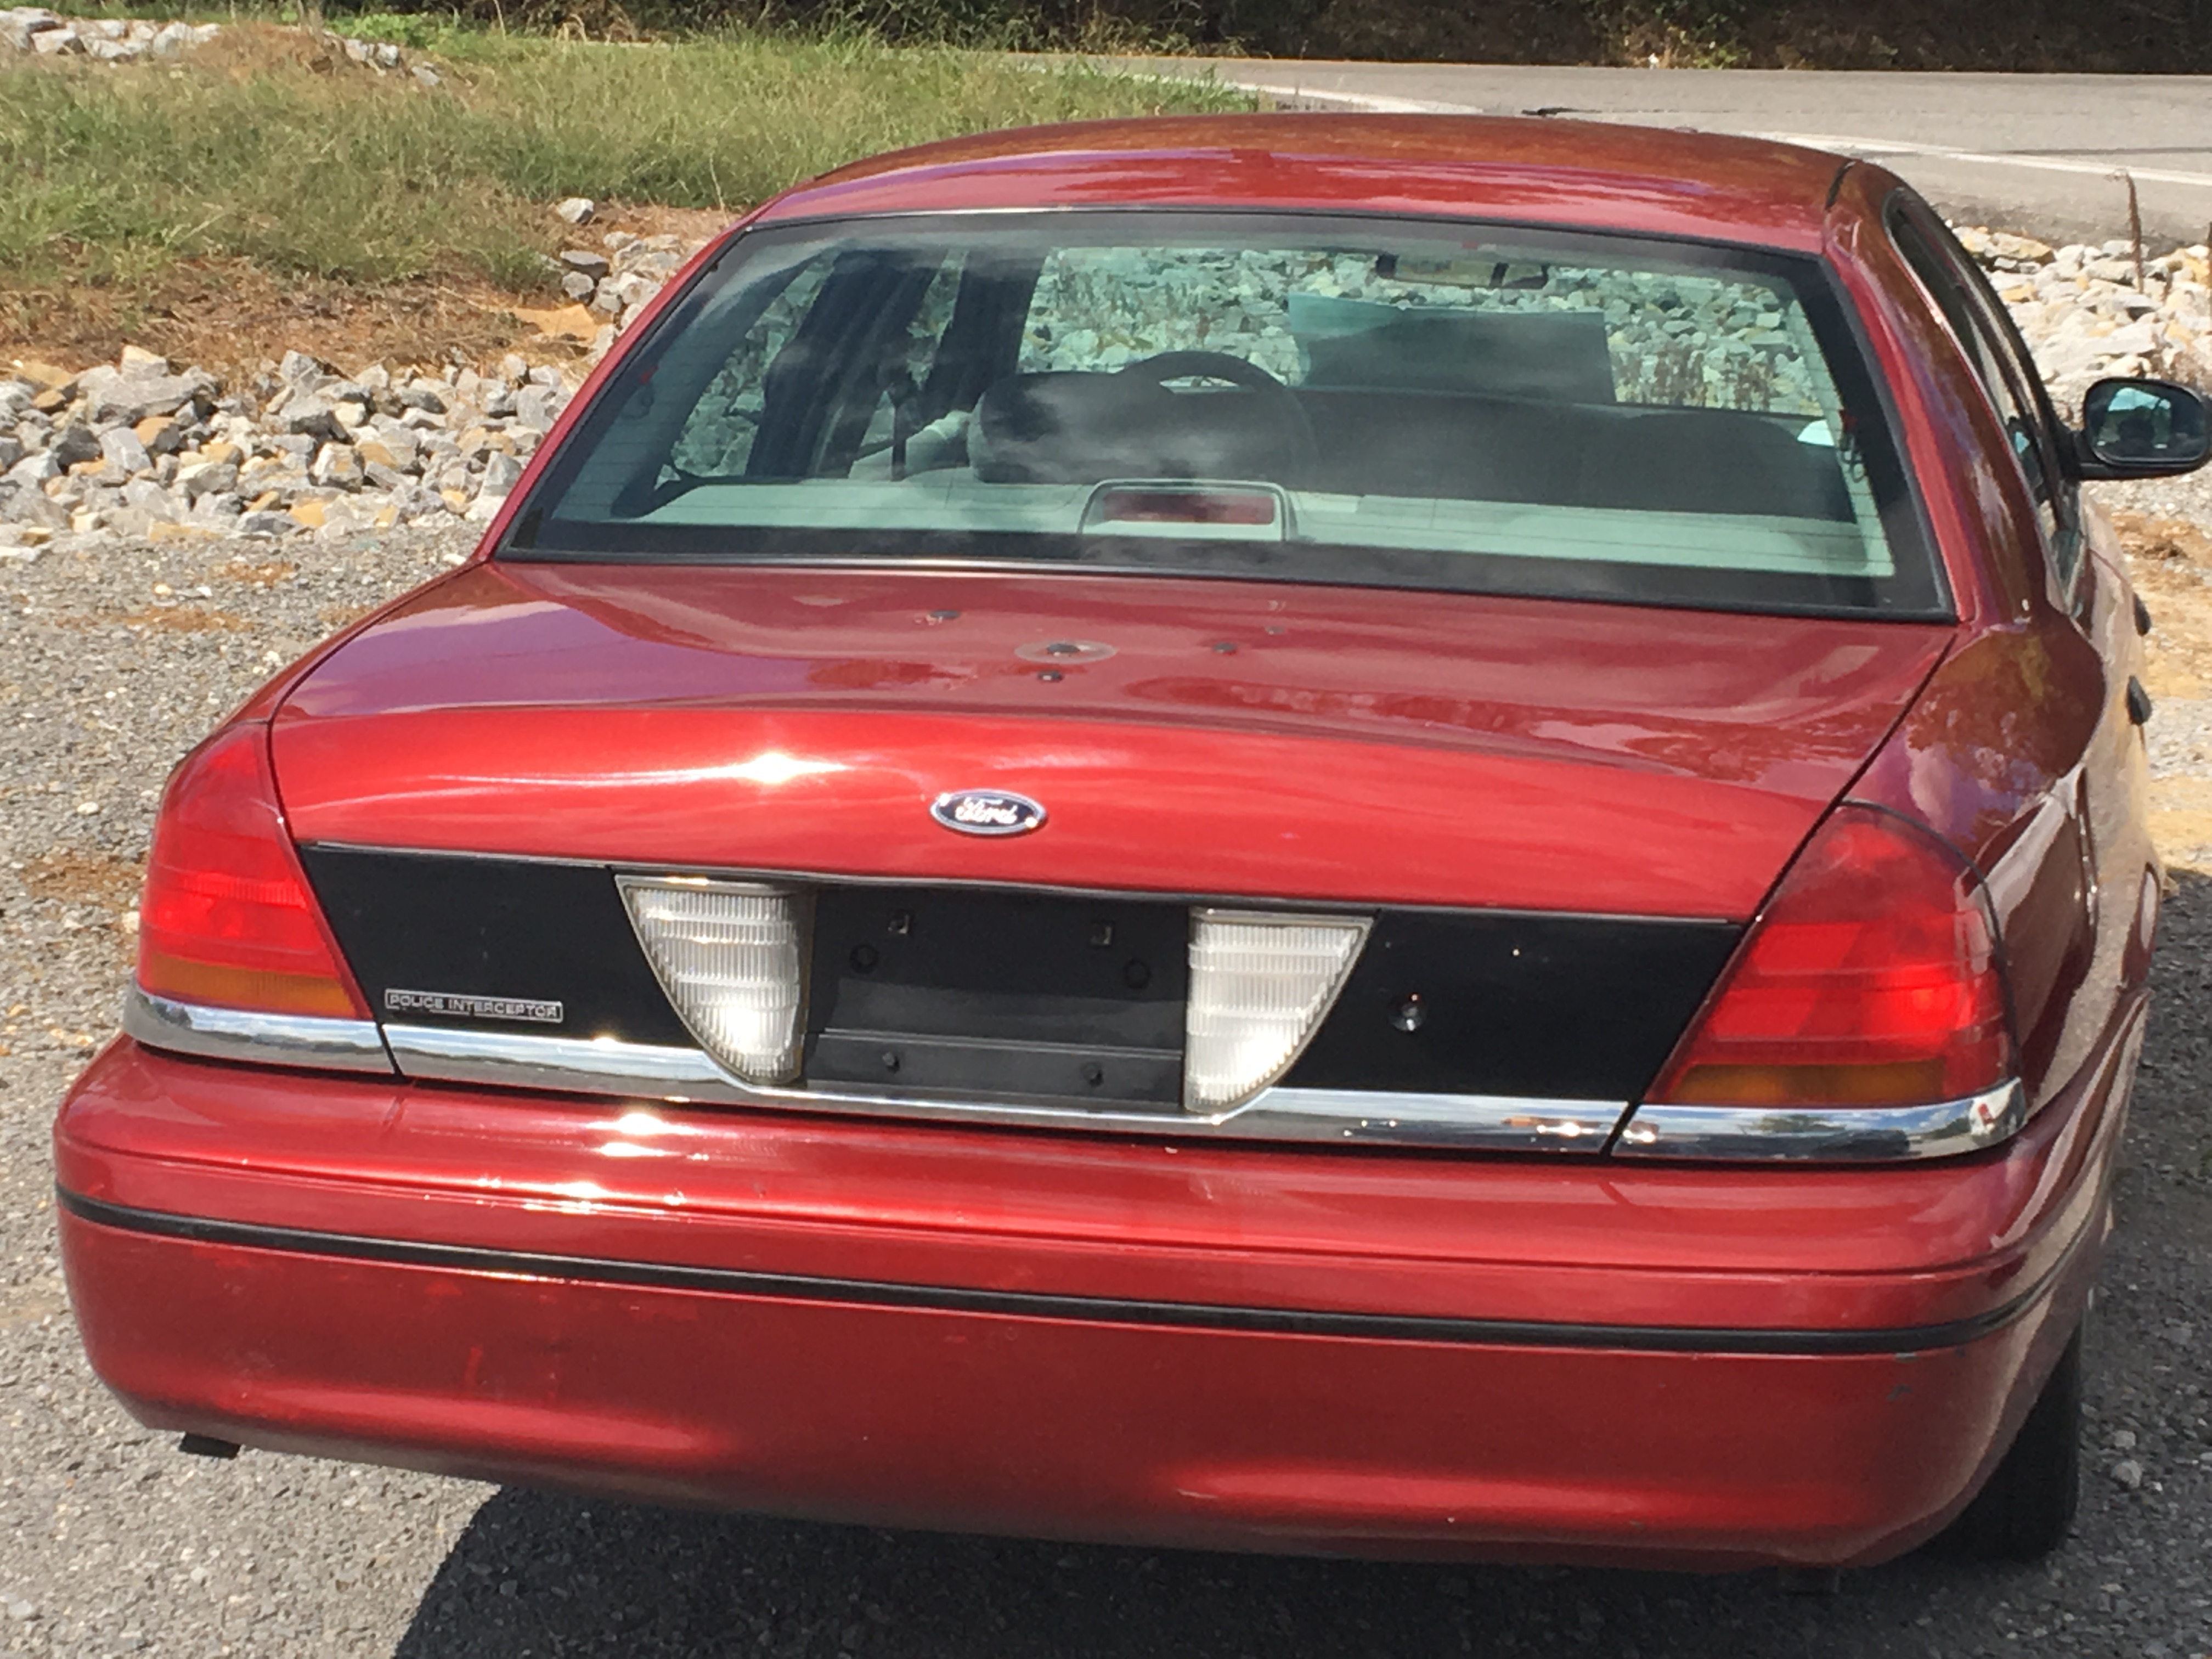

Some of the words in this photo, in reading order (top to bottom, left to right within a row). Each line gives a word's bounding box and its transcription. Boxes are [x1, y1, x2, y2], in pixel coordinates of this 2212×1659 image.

[955, 797, 1018, 824] Ford
[390, 994, 444, 1009] POLICE
[448, 999, 557, 1017] INTERCEPTOR
